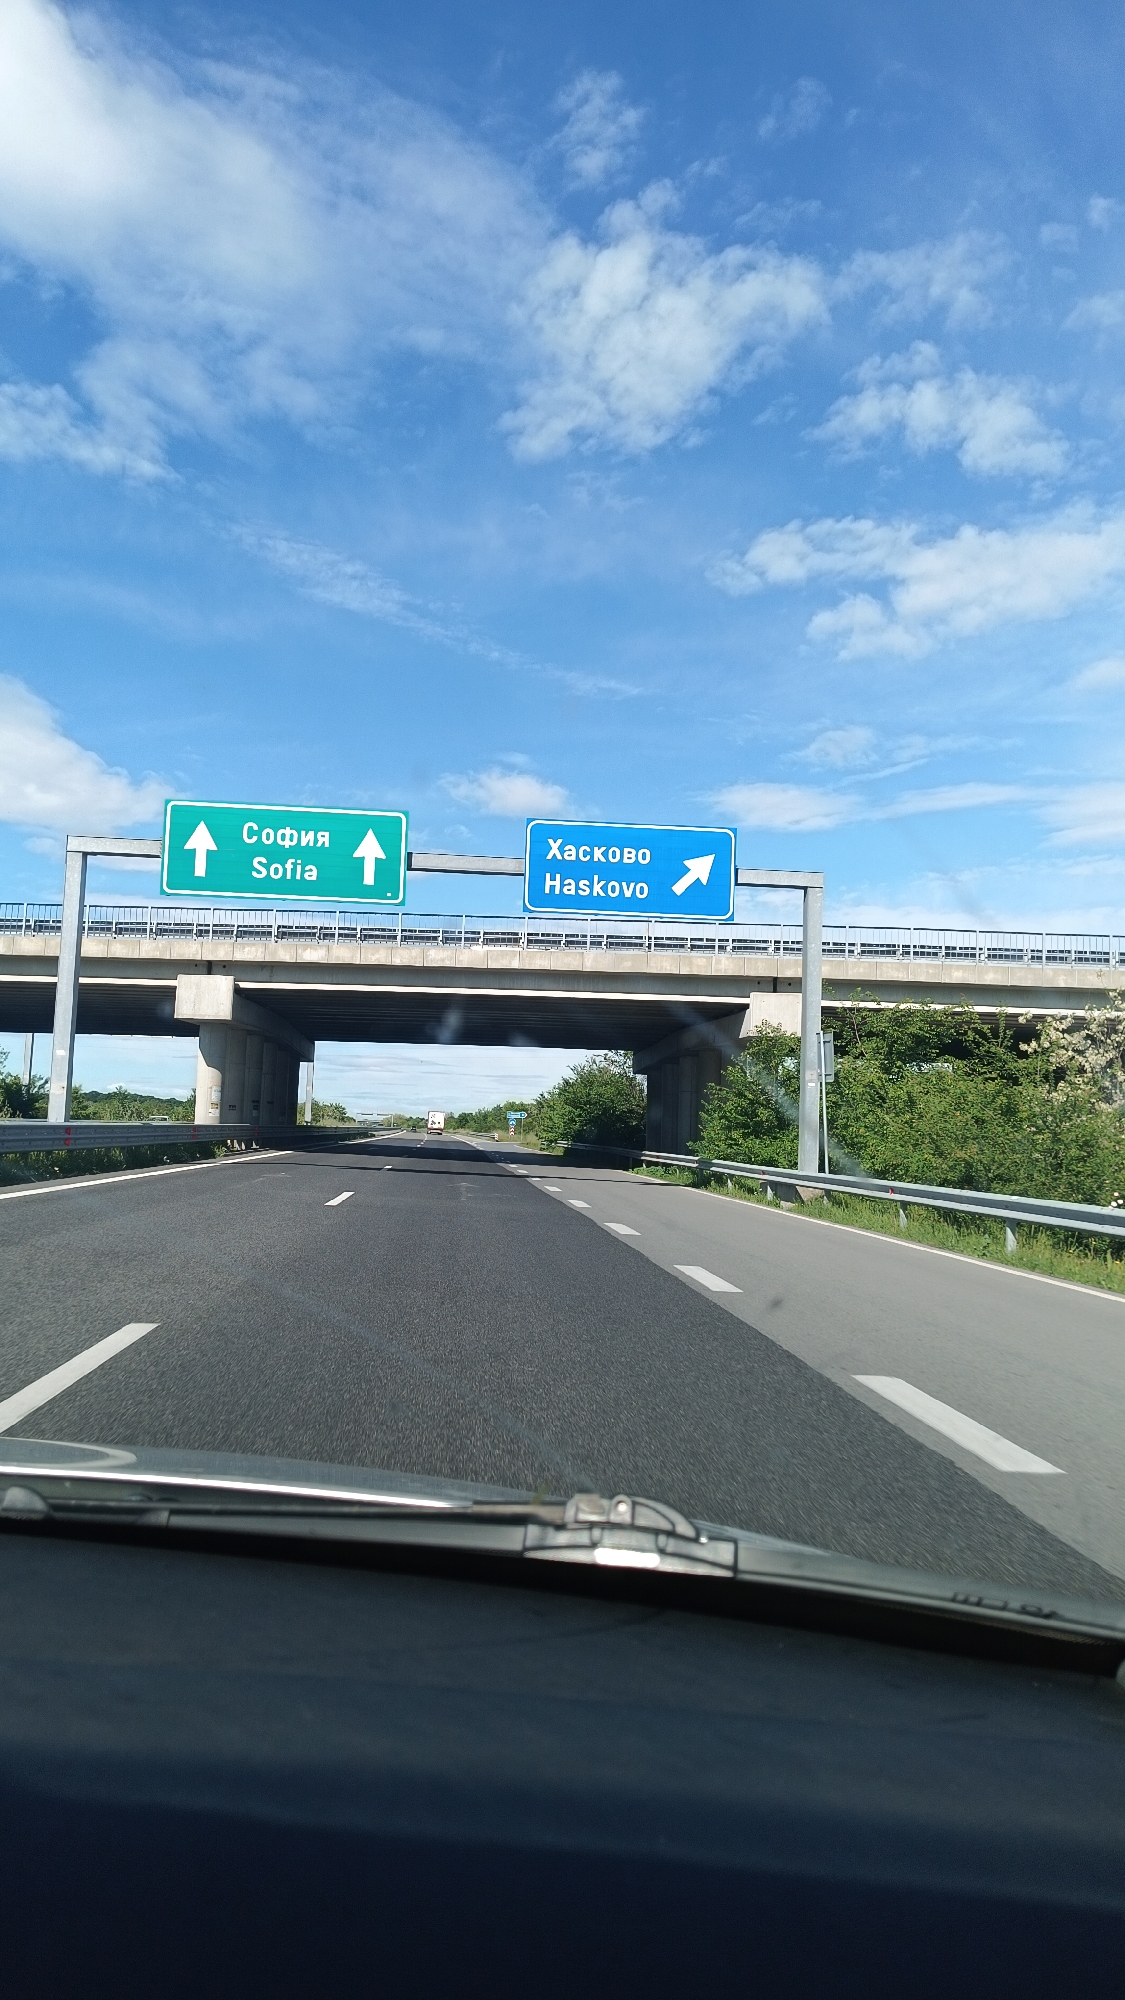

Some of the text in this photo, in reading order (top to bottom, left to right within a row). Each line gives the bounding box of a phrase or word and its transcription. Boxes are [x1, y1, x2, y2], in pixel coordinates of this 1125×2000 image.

[242, 821, 330, 848] София
[546, 838, 651, 865] Хасково
[251, 856, 318, 881] Sofia
[544, 872, 649, 899] Haskovo
